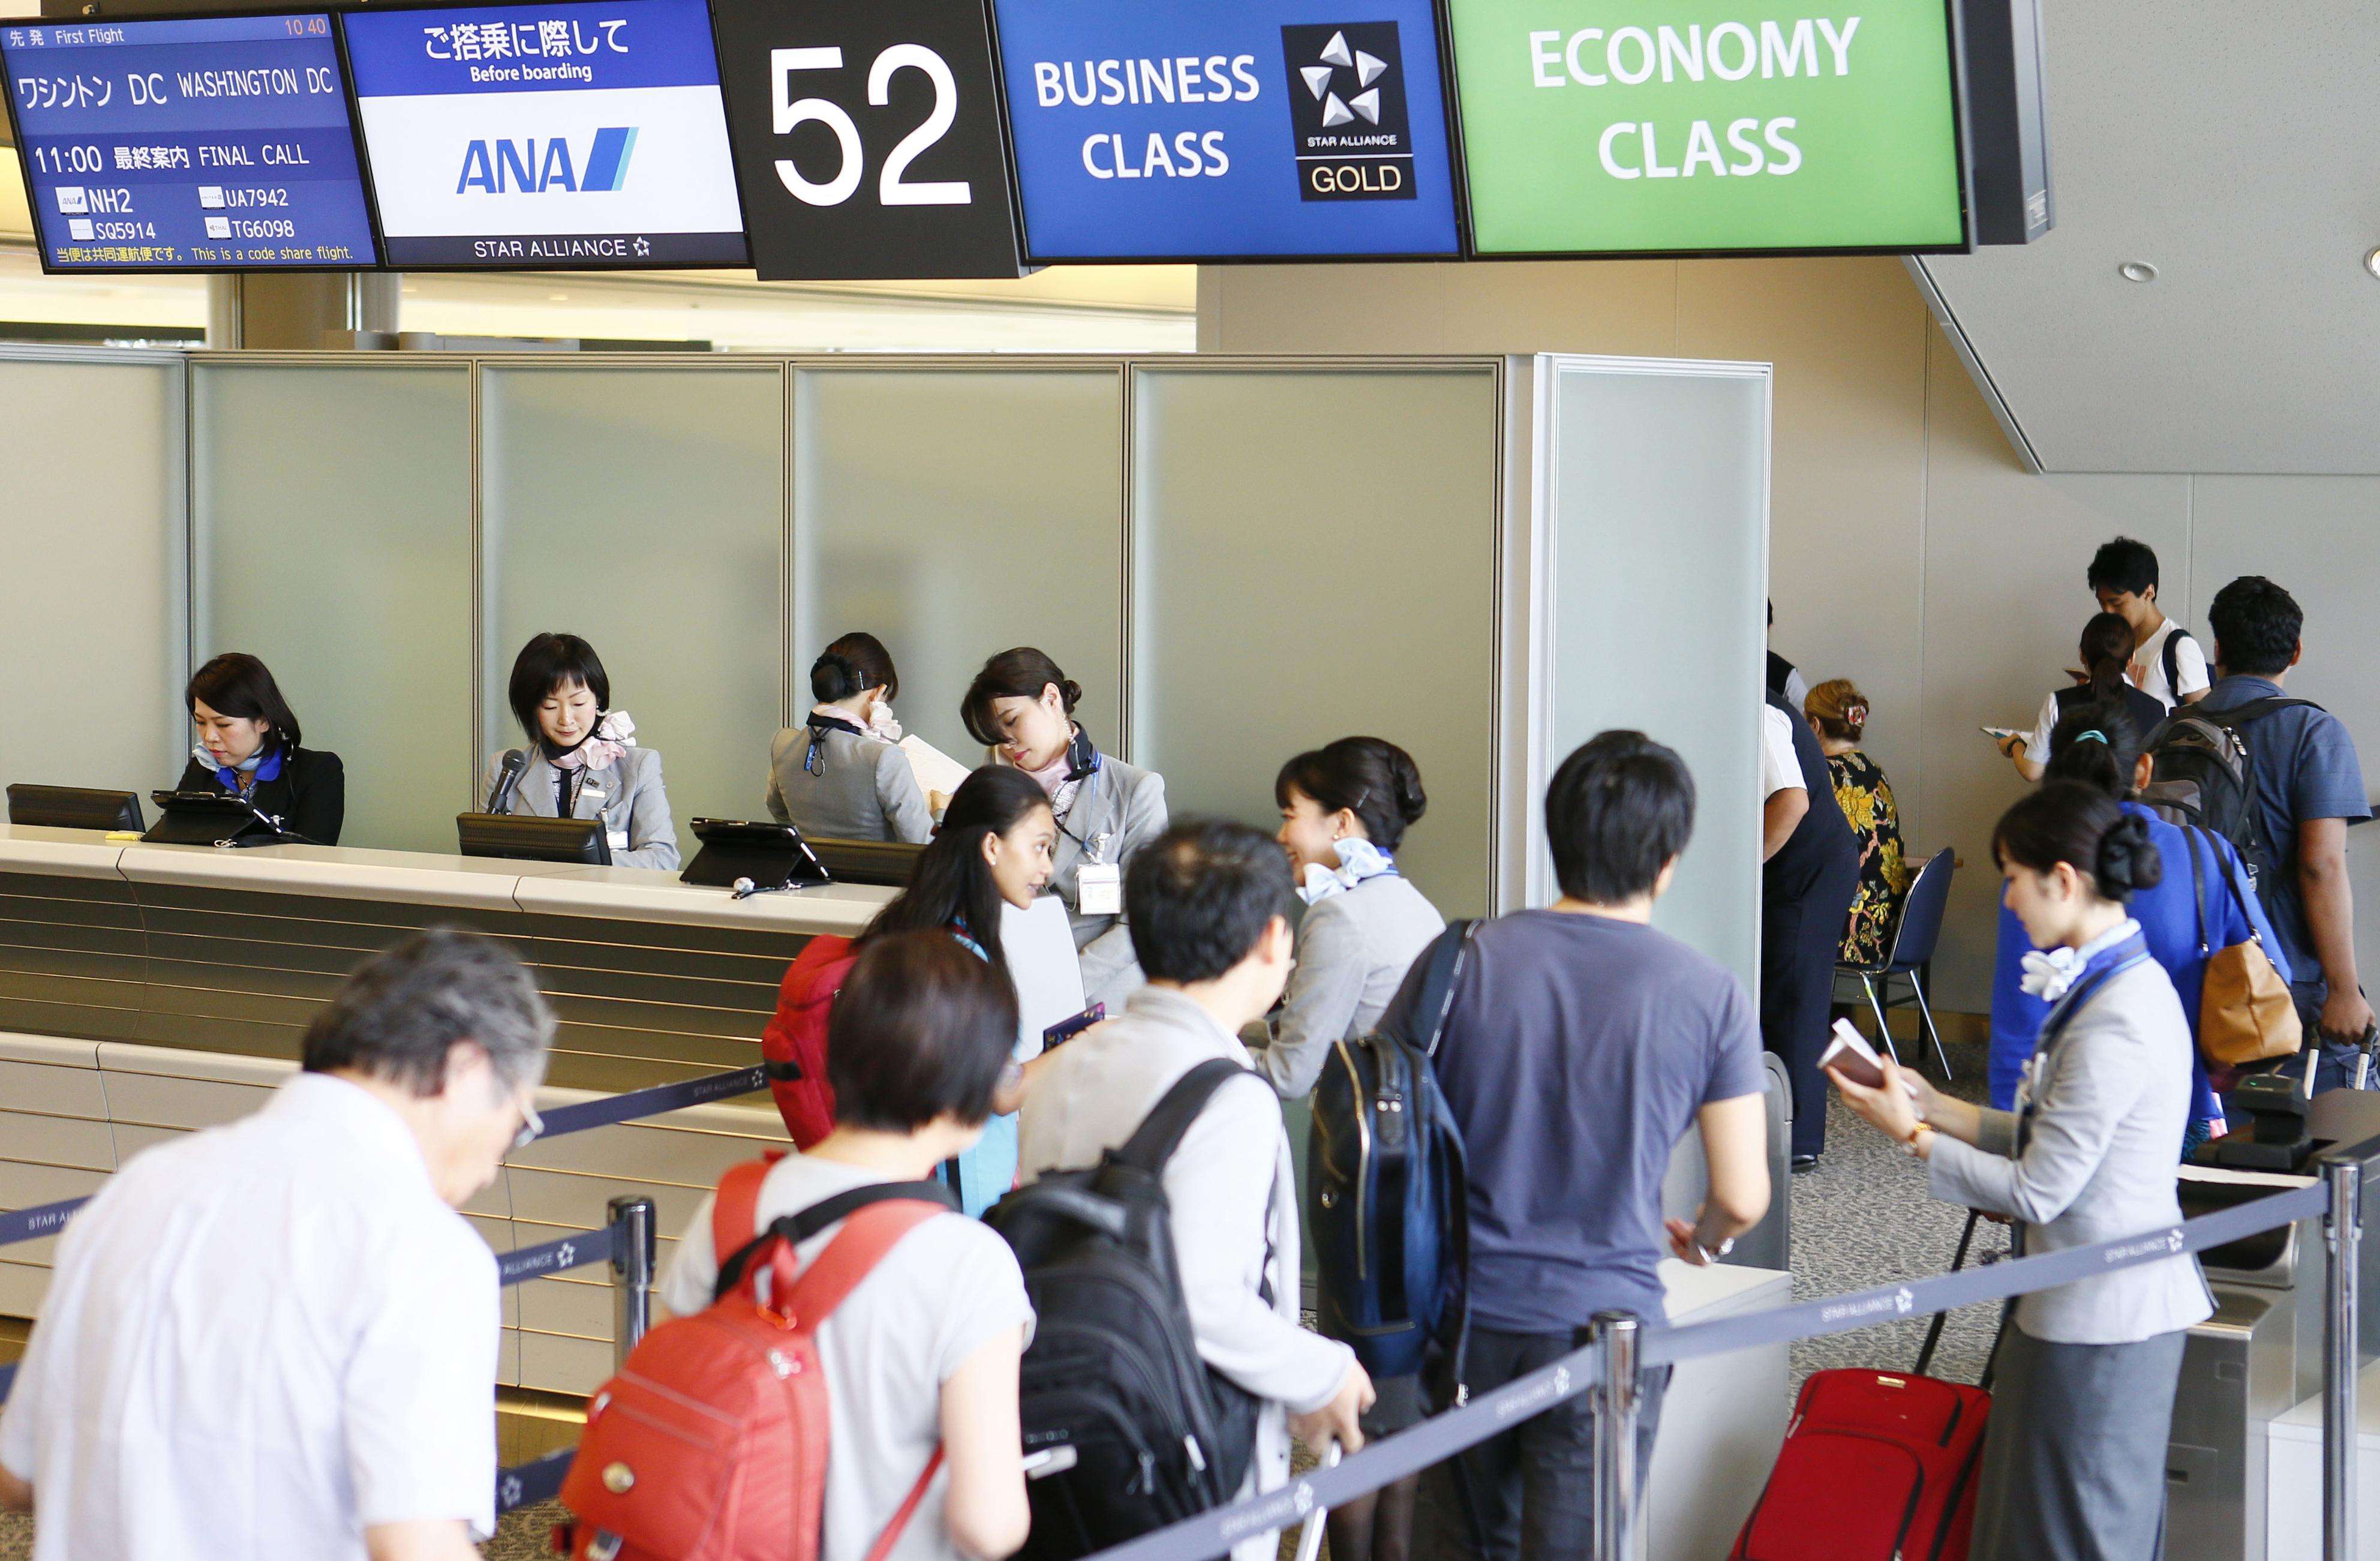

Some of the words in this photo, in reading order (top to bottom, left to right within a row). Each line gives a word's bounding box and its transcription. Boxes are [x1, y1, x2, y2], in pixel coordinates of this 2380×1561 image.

[55, 30, 85, 44] First
[88, 28, 125, 44] Flight
[422, 19, 629, 61] ご搭乗に際して
[1528, 17, 1862, 88] ECONOMY
[177, 68, 299, 98] WASHINGTON
[306, 67, 333, 94] DC
[470, 64, 519, 83] Before
[522, 63, 593, 83] boarding
[1035, 55, 1260, 107] BUSINESS
[18, 74, 112, 109] ワシントン
[128, 72, 167, 106] DC
[770, 43, 972, 207] 52
[1307, 136, 1338, 148] STAR
[1339, 134, 1398, 146] ALLIANCE
[1597, 116, 1803, 180] CLASS
[35, 145, 103, 173] 11:00
[114, 146, 191, 171] 最終案内
[199, 145, 254, 167] FINAL
[262, 144, 309, 165] CALL
[456, 137, 578, 195] ANA
[1081, 130, 1230, 179] CLASS
[1312, 164, 1402, 193] GOLD
[88, 188, 134, 213] NH2
[225, 188, 289, 208] UA7942
[95, 221, 157, 240] SQ5914
[232, 220, 295, 238] TG6098
[56, 246, 183, 263] 当便は共同運航便です。
[191, 248, 217, 260] This
[220, 247, 232, 260] is
[236, 250, 244, 260] a
[248, 247, 276, 260] code
[281, 246, 312, 260] share
[316, 246, 353, 260] flight.
[474, 241, 524, 258] STAR
[530, 239, 627, 257] ALLIANCE
[28, 1212, 56, 1231] STAR
